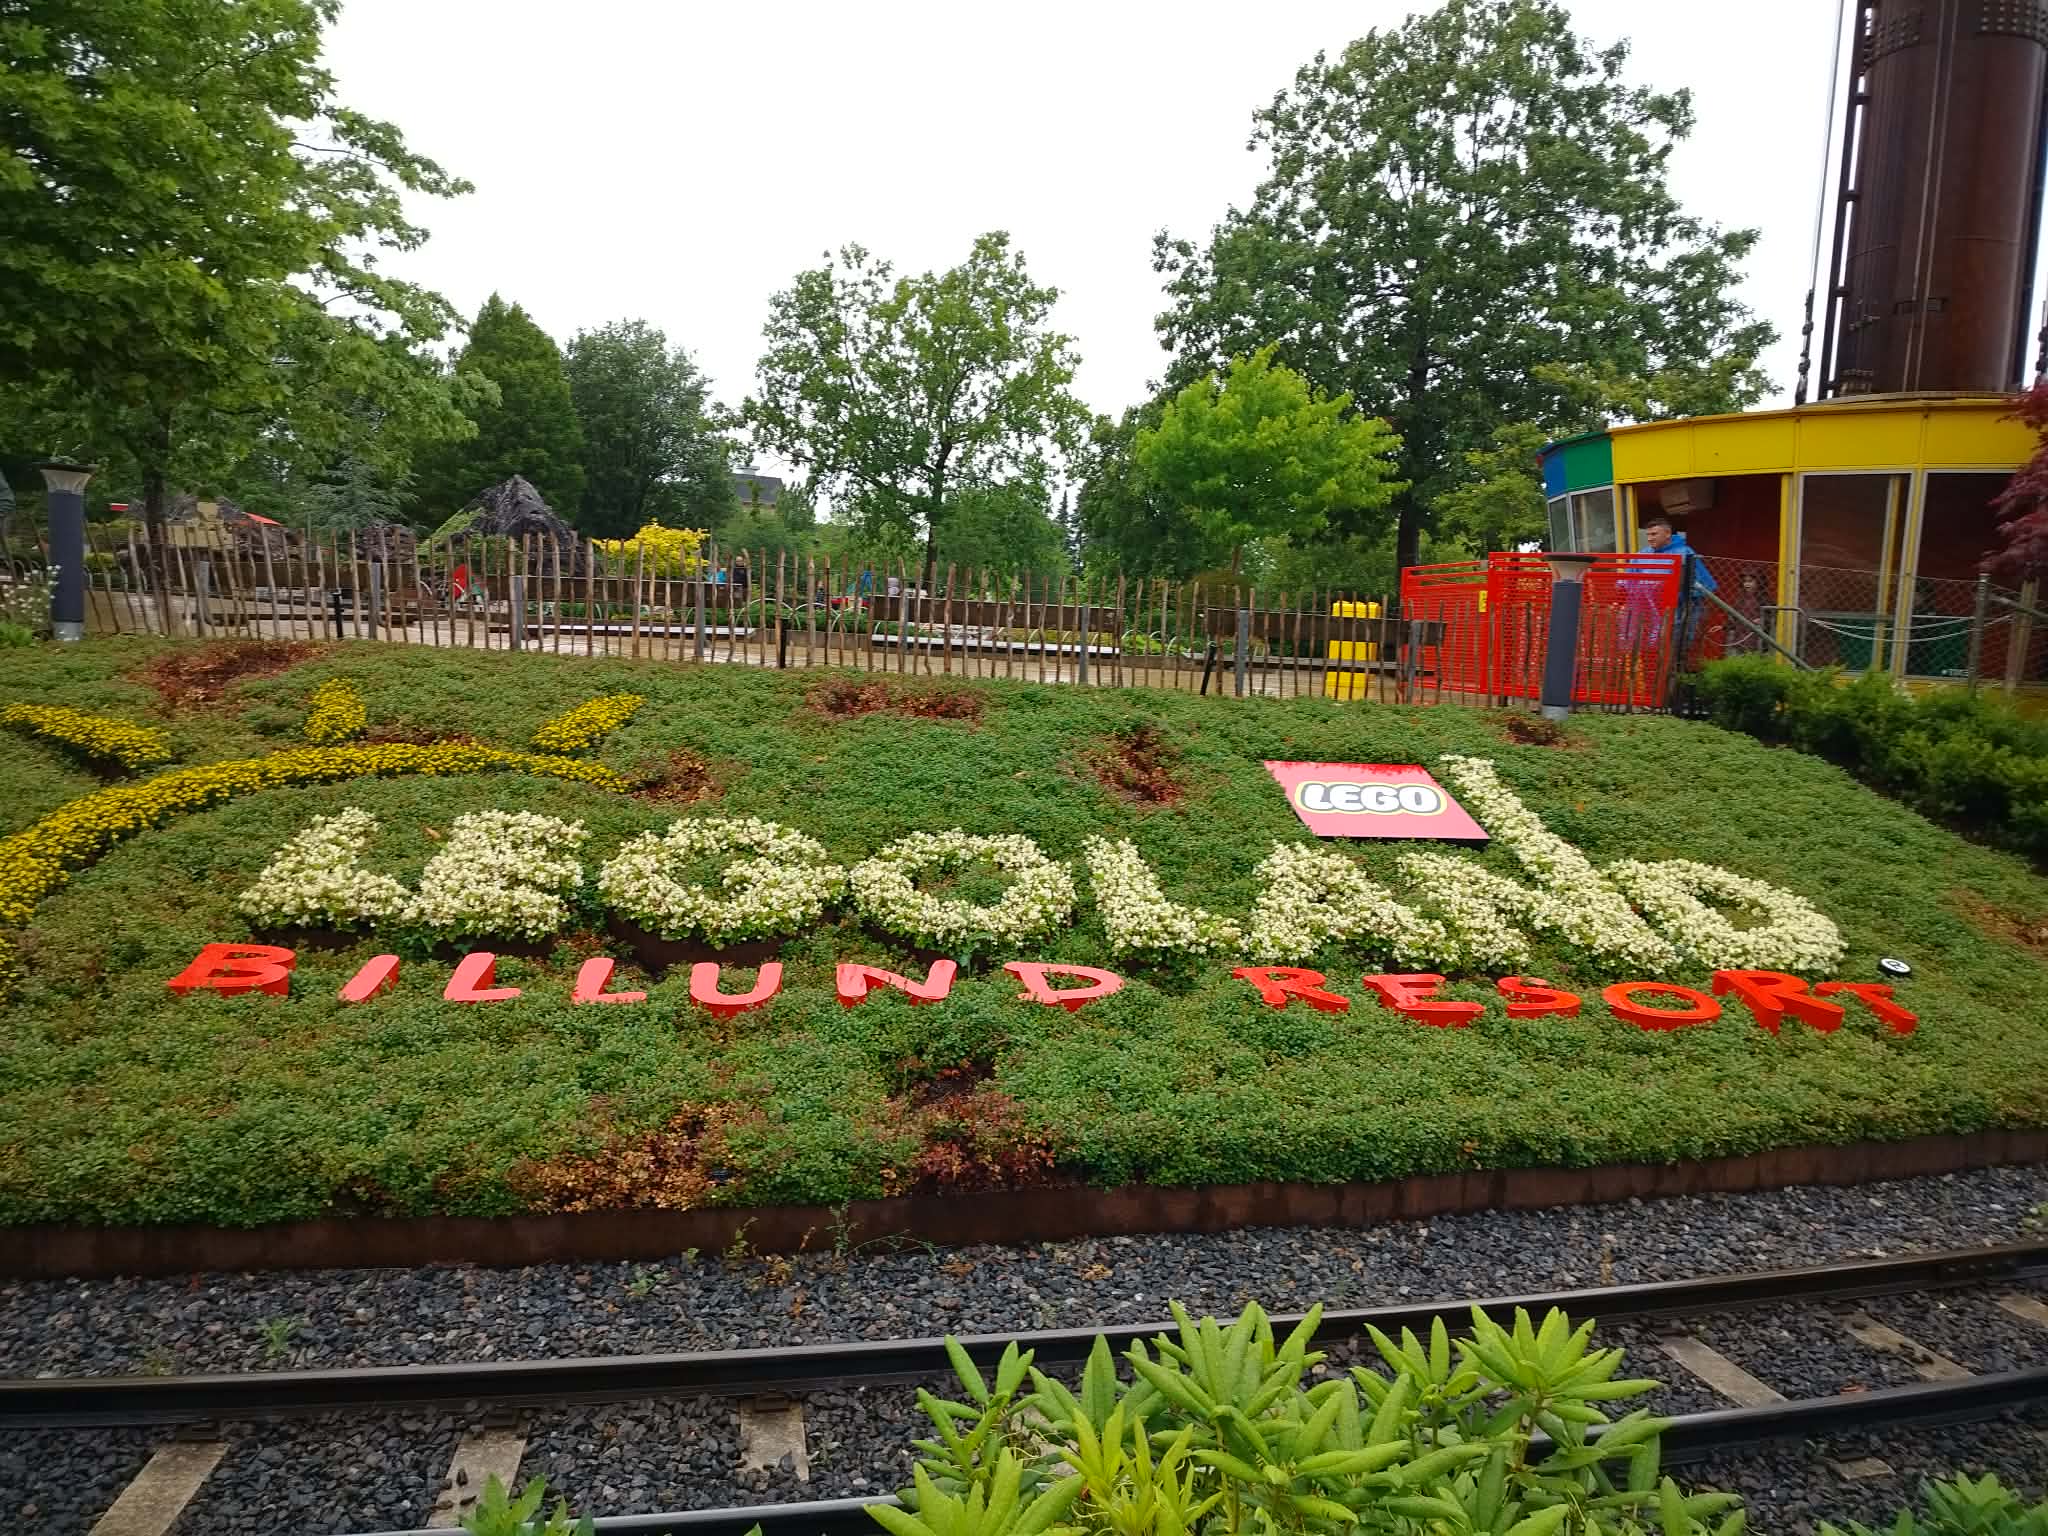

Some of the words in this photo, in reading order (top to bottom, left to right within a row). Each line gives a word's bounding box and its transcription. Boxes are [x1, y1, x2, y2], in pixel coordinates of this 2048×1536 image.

[1301, 782, 1441, 814] LEGO
[238, 754, 1847, 976] LEGOLAND
[167, 943, 1125, 1019] BILLUND
[1231, 967, 1919, 1035] RESORT
